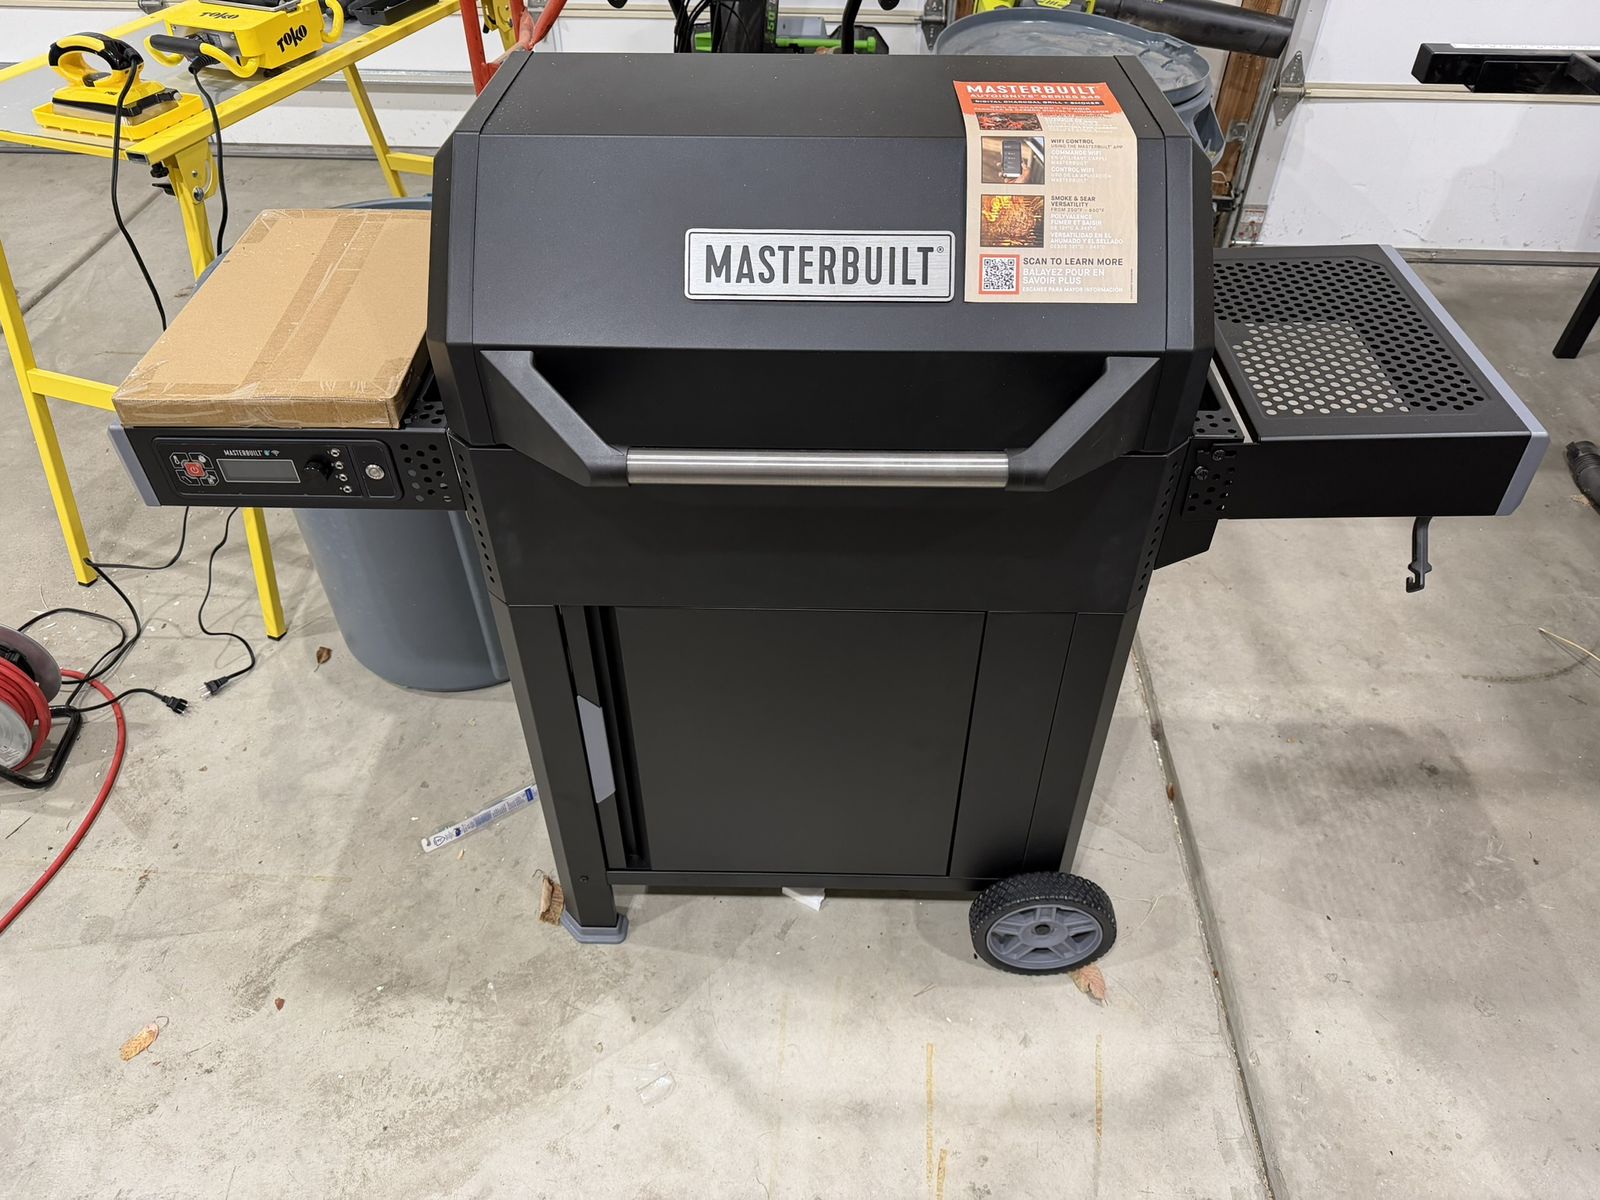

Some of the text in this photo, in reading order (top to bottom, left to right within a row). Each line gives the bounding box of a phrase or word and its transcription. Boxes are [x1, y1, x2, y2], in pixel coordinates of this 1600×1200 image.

[966, 85, 1097, 95] MASTERBUILT
[1023, 257, 1048, 265] SCAN
[1023, 268, 1104, 276] BALAYEZ POUR EN
[1023, 276, 1082, 285] SAVOIR PLUS
